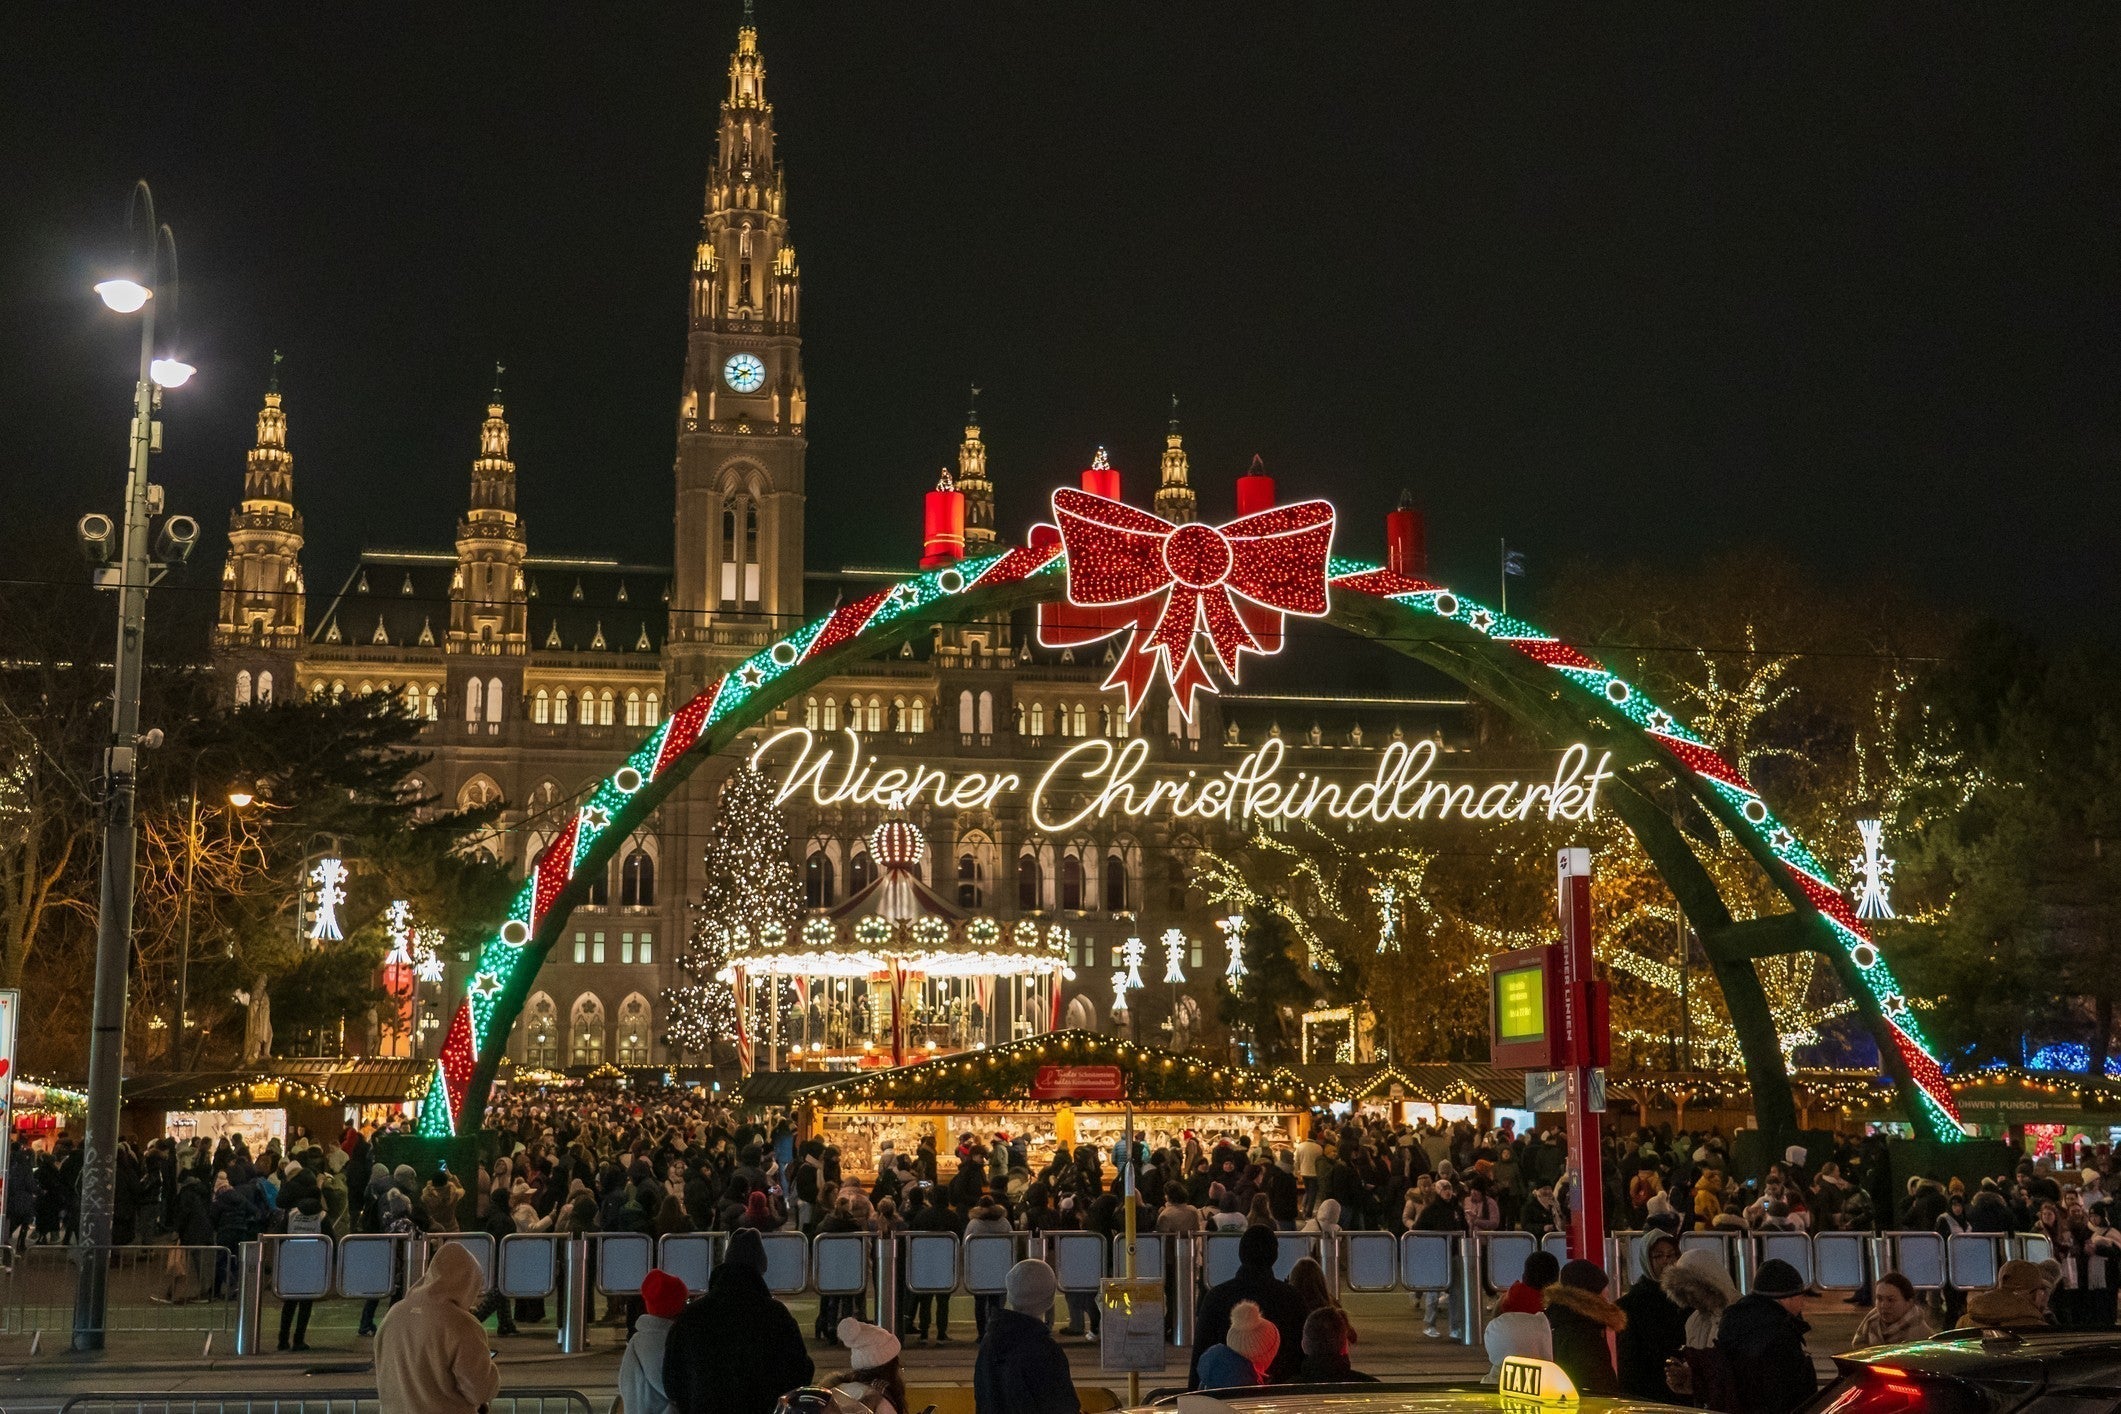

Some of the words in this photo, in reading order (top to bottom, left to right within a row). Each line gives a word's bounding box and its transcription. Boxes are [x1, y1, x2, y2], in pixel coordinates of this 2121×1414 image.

[751, 727, 1019, 809] Wiener
[1031, 737, 1614, 832] Christkindlmarkt
[1563, 923, 1571, 985] WIENER
[1565, 989, 1573, 1041] LINIEN
[1569, 1101, 1575, 1115] D
[1958, 1099, 1996, 1110] ÜHWEIN
[2000, 1101, 2039, 1110] PUNSCH
[1505, 1364, 1540, 1395] TAXI
